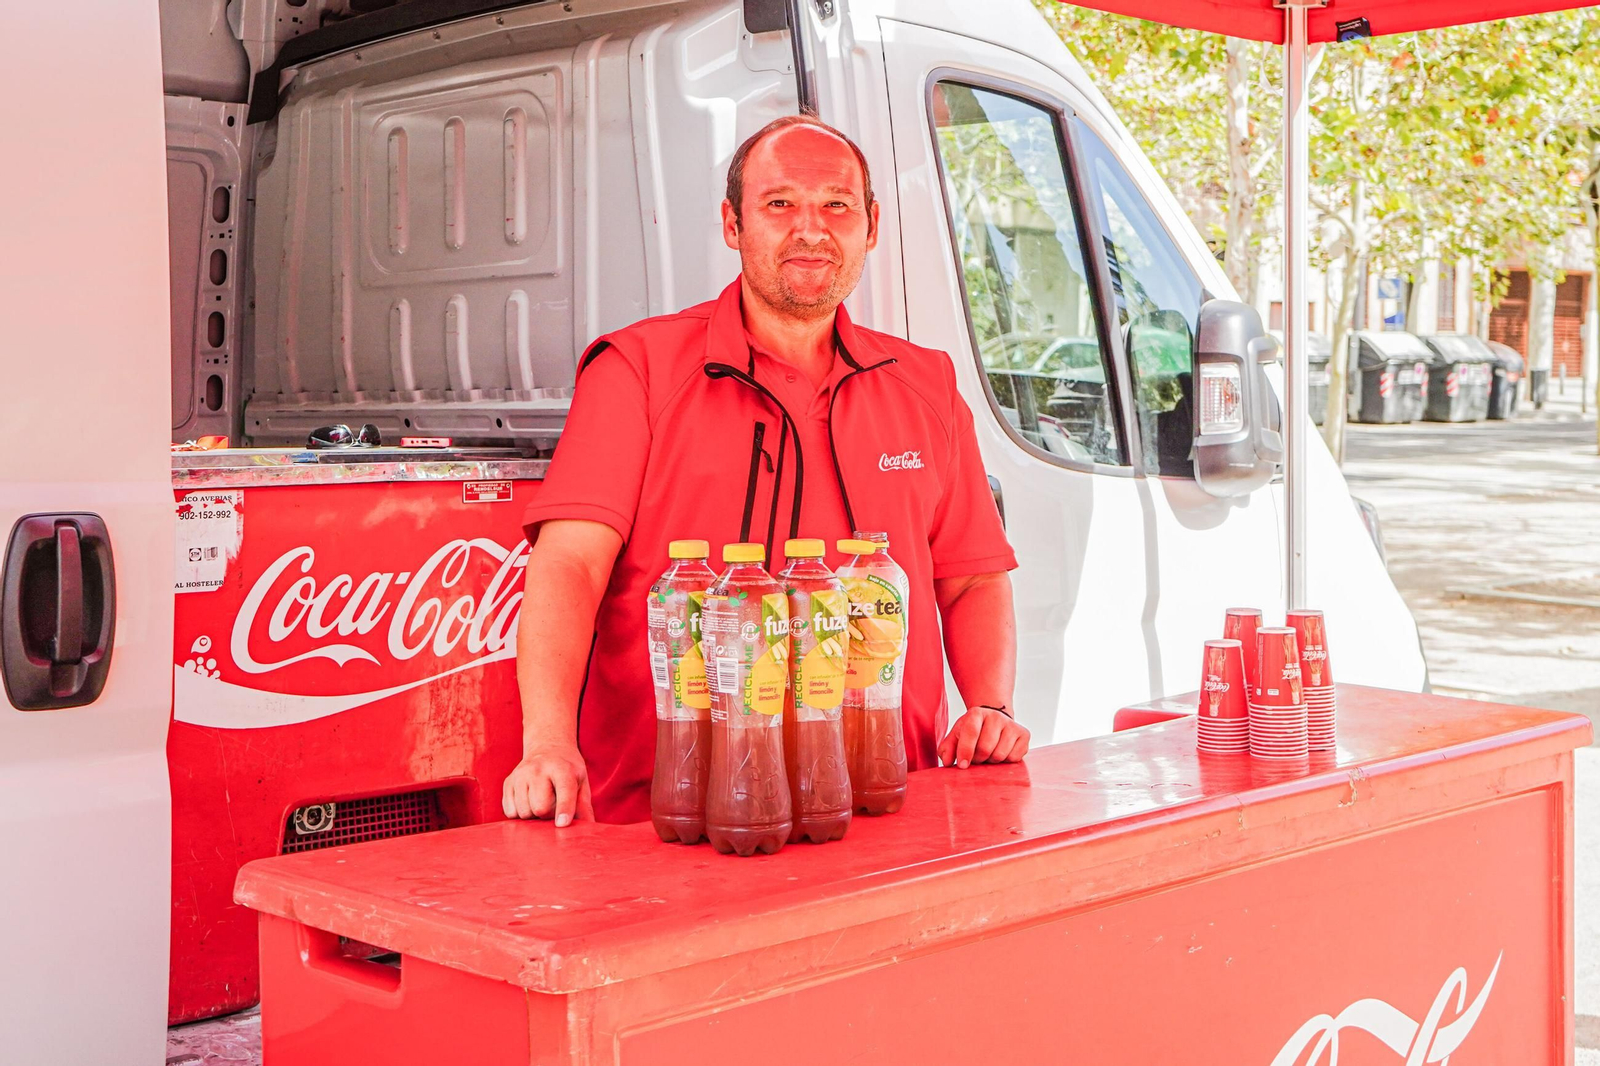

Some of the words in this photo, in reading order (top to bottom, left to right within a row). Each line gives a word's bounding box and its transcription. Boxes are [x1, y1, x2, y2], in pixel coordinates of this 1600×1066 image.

[878, 450, 922, 471] Coca-Cola
[180, 510, 231, 520] 902-152-992
[764, 615, 789, 636] fuz
